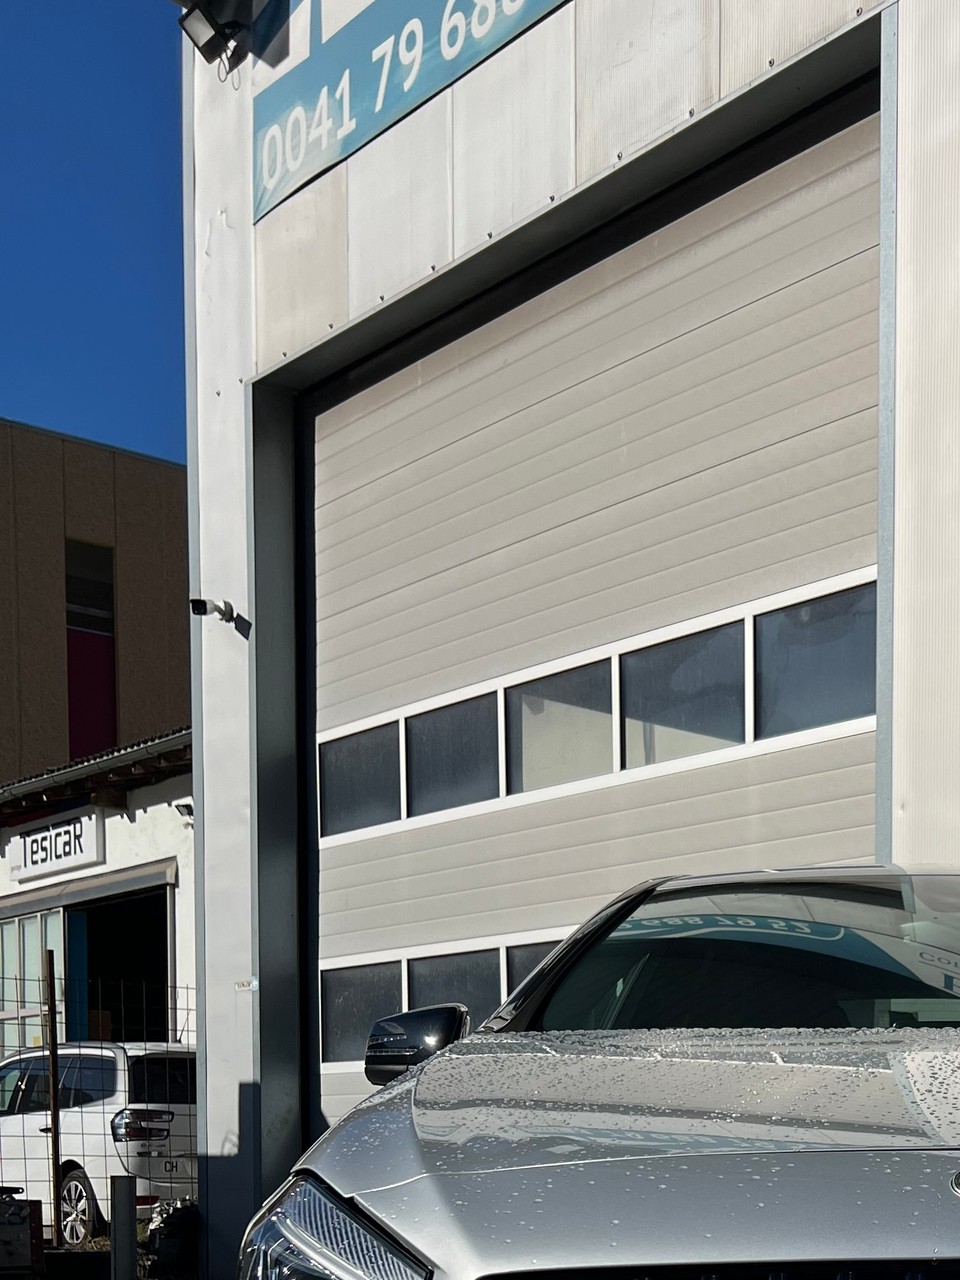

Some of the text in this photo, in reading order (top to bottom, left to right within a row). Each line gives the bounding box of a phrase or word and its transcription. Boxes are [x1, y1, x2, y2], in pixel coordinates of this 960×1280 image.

[261, 68, 357, 190] 0041
[371, 17, 425, 114] 79
[164, 1160, 178, 1173] CH
